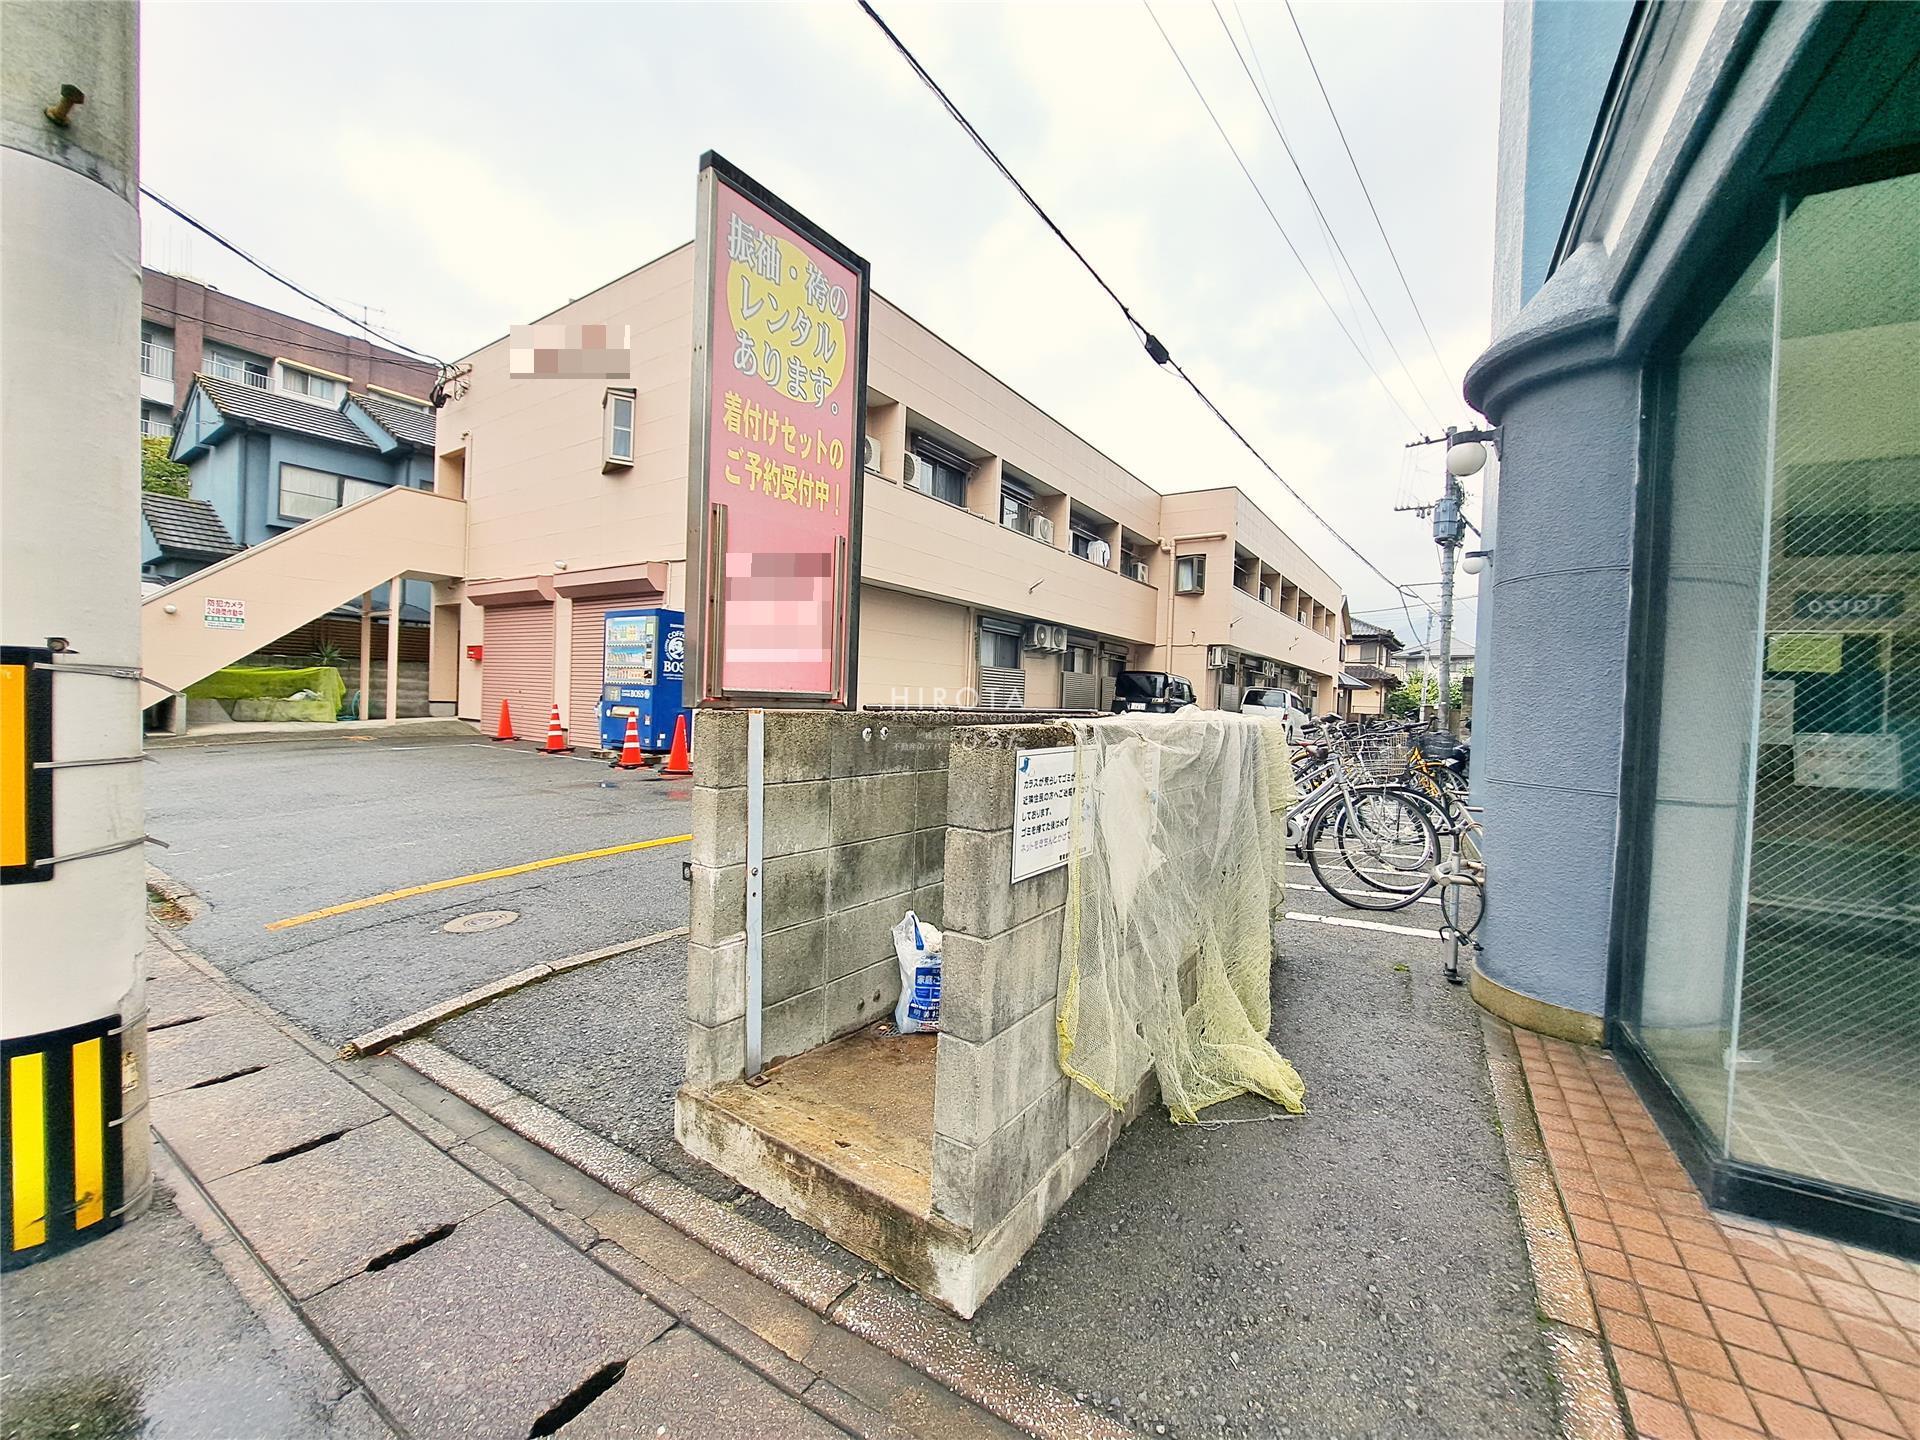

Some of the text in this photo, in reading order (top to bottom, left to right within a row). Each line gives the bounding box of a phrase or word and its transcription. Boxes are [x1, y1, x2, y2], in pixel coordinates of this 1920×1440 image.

[727, 212, 849, 321] 振袖・袴の
[740, 274, 837, 364] レンタル
[733, 328, 838, 415] あります。
[722, 390, 844, 471] 着付けセットの
[724, 446, 841, 516] ご予約受付中！
[207, 599, 244, 608] 防犯カメラ
